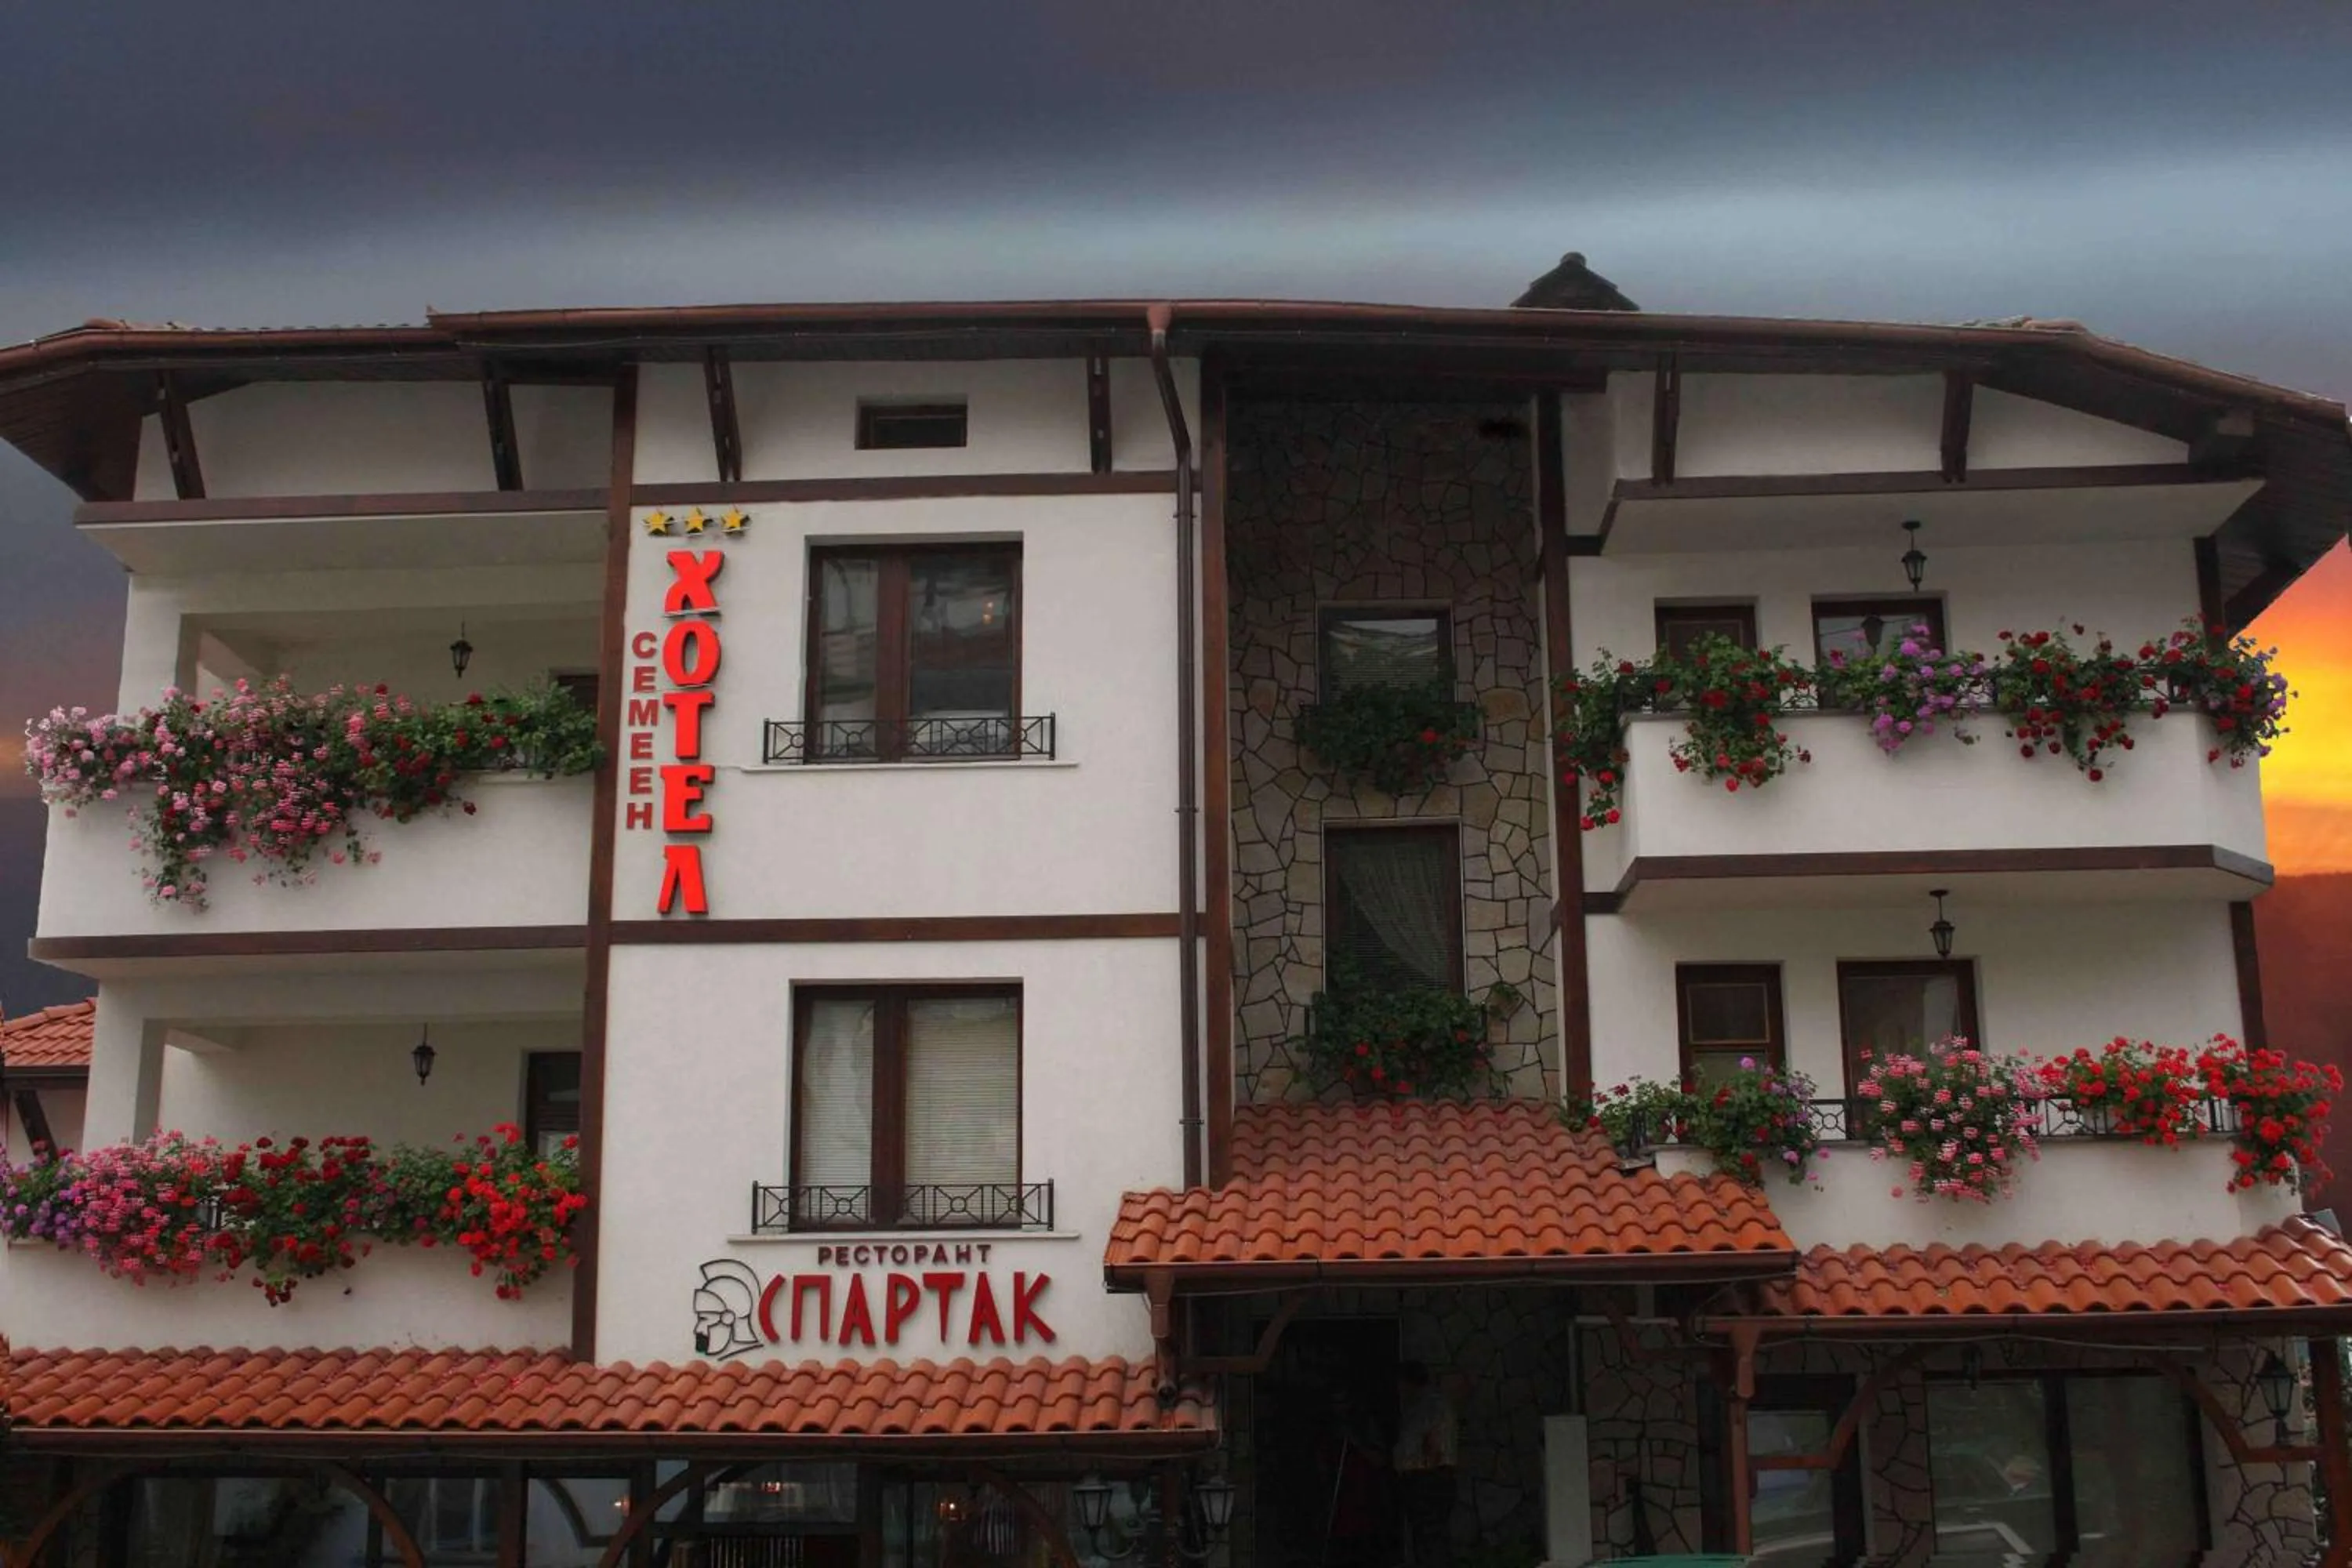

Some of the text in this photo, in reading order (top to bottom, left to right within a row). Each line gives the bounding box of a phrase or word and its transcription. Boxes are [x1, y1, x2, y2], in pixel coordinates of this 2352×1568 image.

[627, 631, 659, 829] СЕМЕЕН
[657, 550, 724, 915] ХОТЕЛ
[758, 1272, 1056, 1348] СПАРТАК
[818, 1244, 992, 1266] РЕСТОРАНТ
